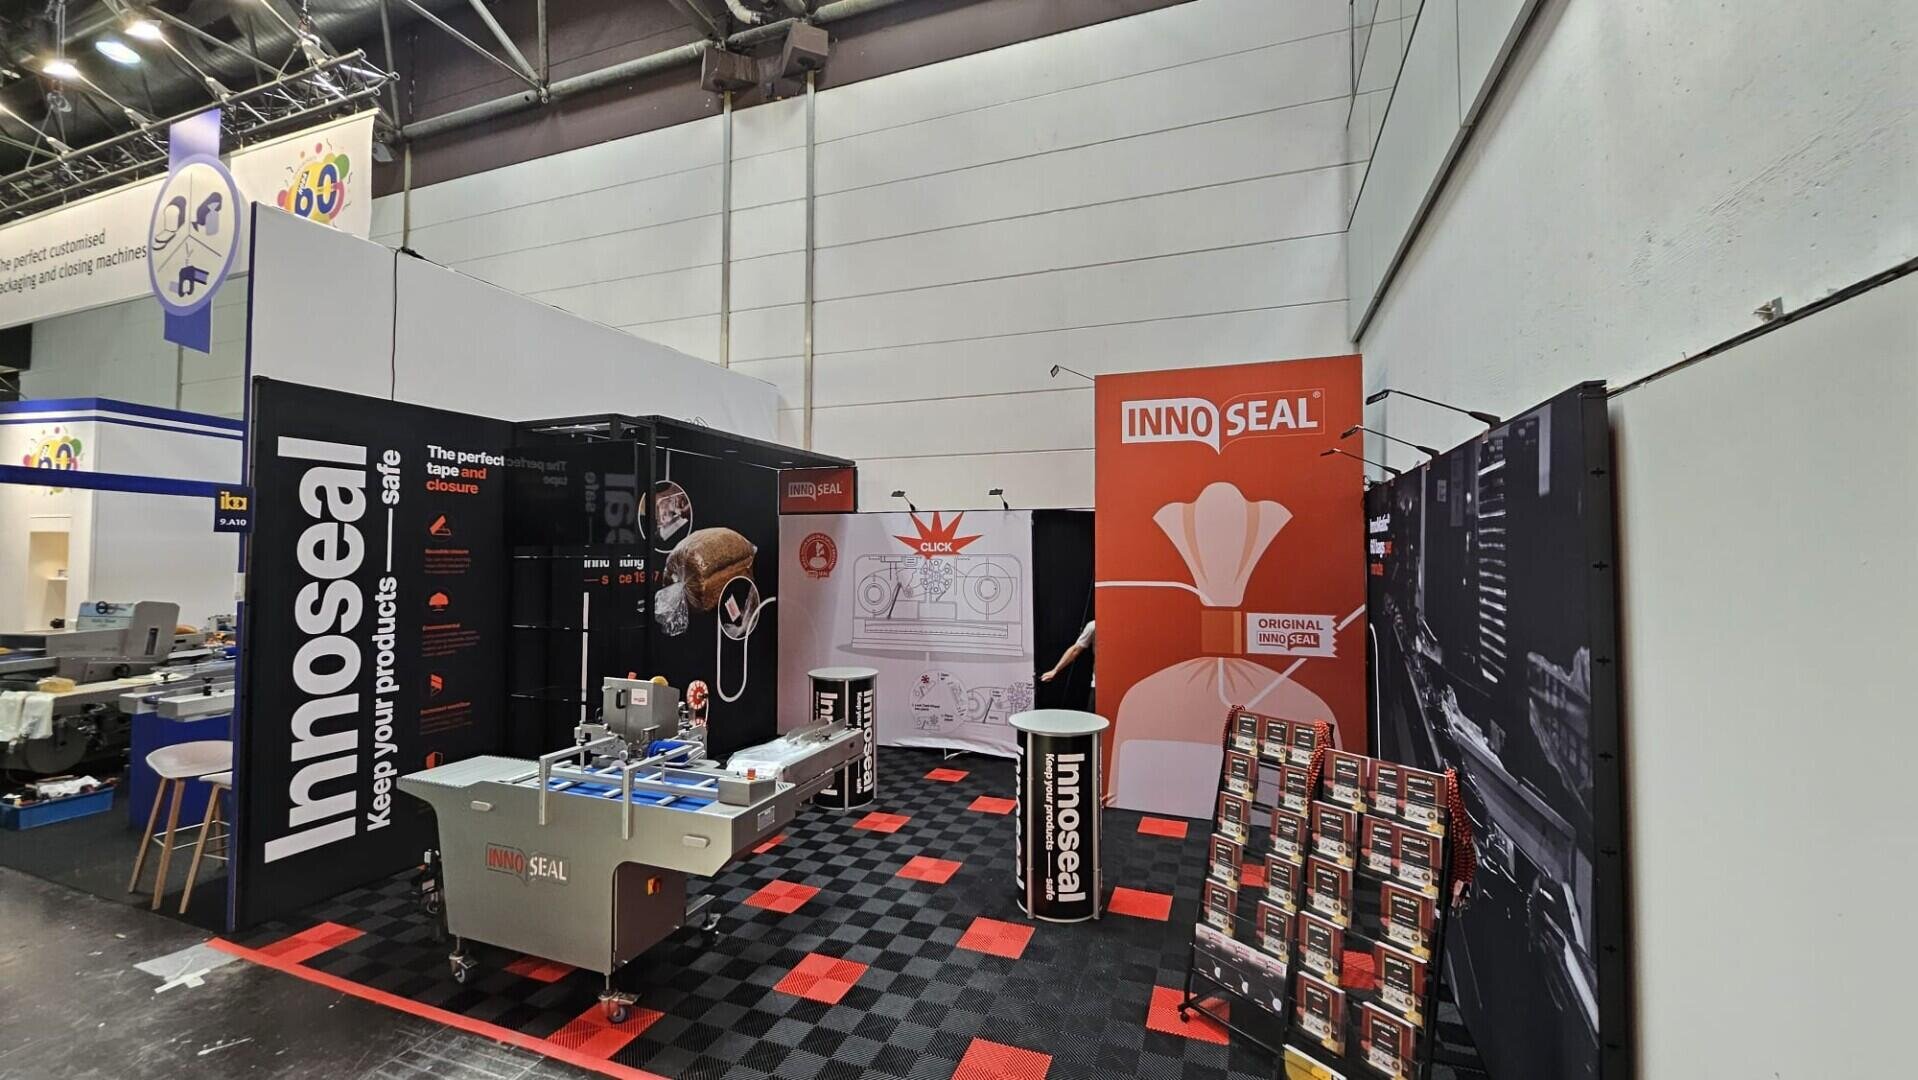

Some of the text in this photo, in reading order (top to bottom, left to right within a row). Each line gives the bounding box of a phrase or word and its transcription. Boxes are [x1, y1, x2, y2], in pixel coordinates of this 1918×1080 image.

[0, 228, 106, 272] he perfect customised
[0, 245, 147, 294] ackaging and closing machines
[426, 461, 488, 480] tape and
[427, 444, 505, 467] The perfect
[426, 479, 479, 495] closure
[219, 518, 247, 526] 9.A10
[920, 542, 953, 552] CLICK
[601, 574, 633, 586] sce
[367, 449, 402, 832] Keep your products safe
[1258, 618, 1324, 631] ORIGINAL
[264, 435, 367, 864] Innoseal
[862, 689, 874, 793] Innoseal
[1044, 753, 1056, 902] Keep your products safe
[1057, 753, 1086, 902] Innoseal
